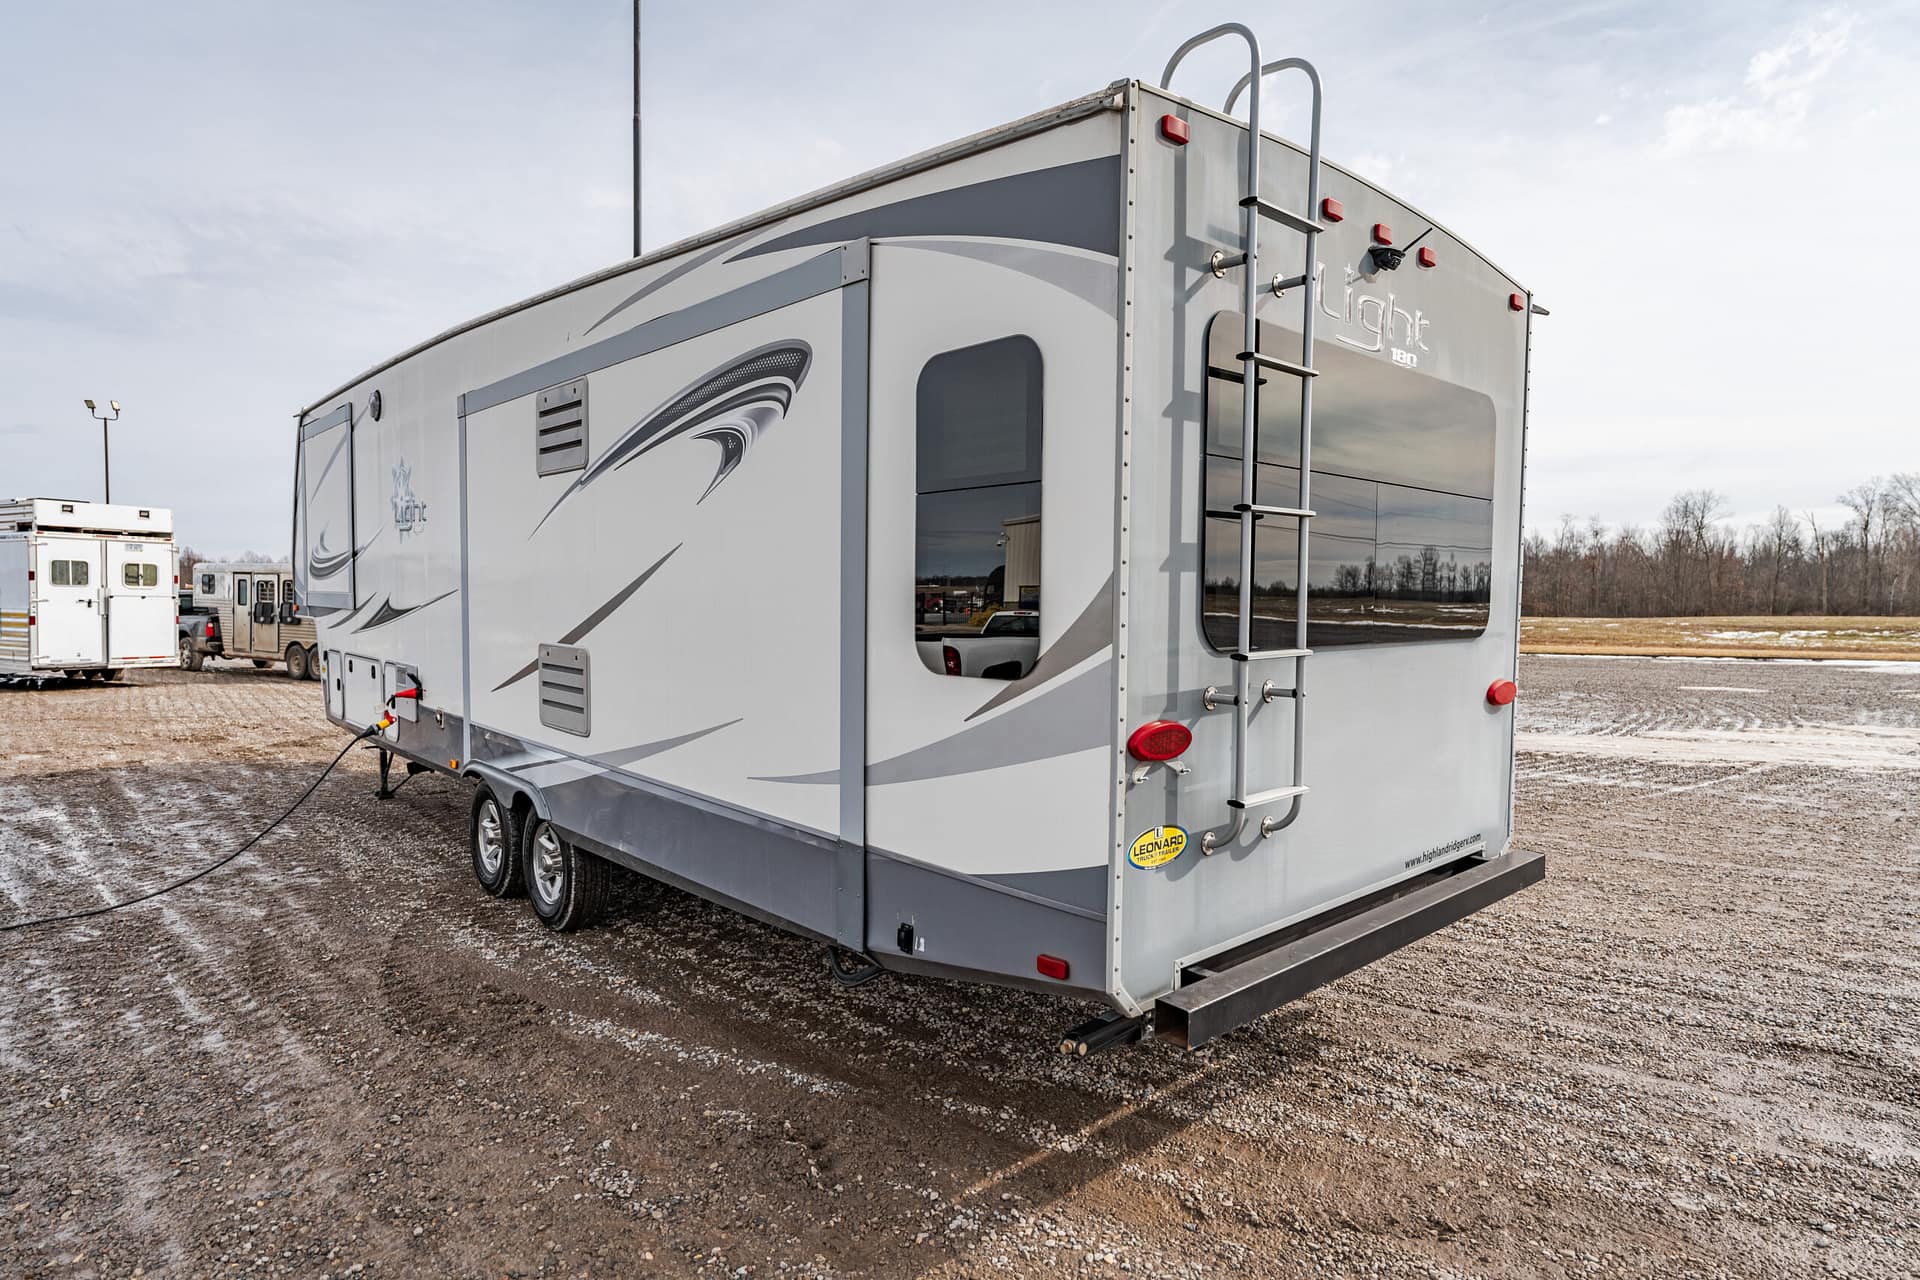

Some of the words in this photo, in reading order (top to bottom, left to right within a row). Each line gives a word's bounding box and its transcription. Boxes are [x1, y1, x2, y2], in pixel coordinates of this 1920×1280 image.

[1316, 261, 1430, 353] Light
[1391, 347, 1417, 367] 180
[394, 497, 427, 532] Light
[1133, 835, 1183, 856] LEONARD
[1137, 854, 1154, 863] TRUCK
[1158, 846, 1180, 856] TRAILER
[1405, 833, 1481, 868] www.highlandridgerv.com
